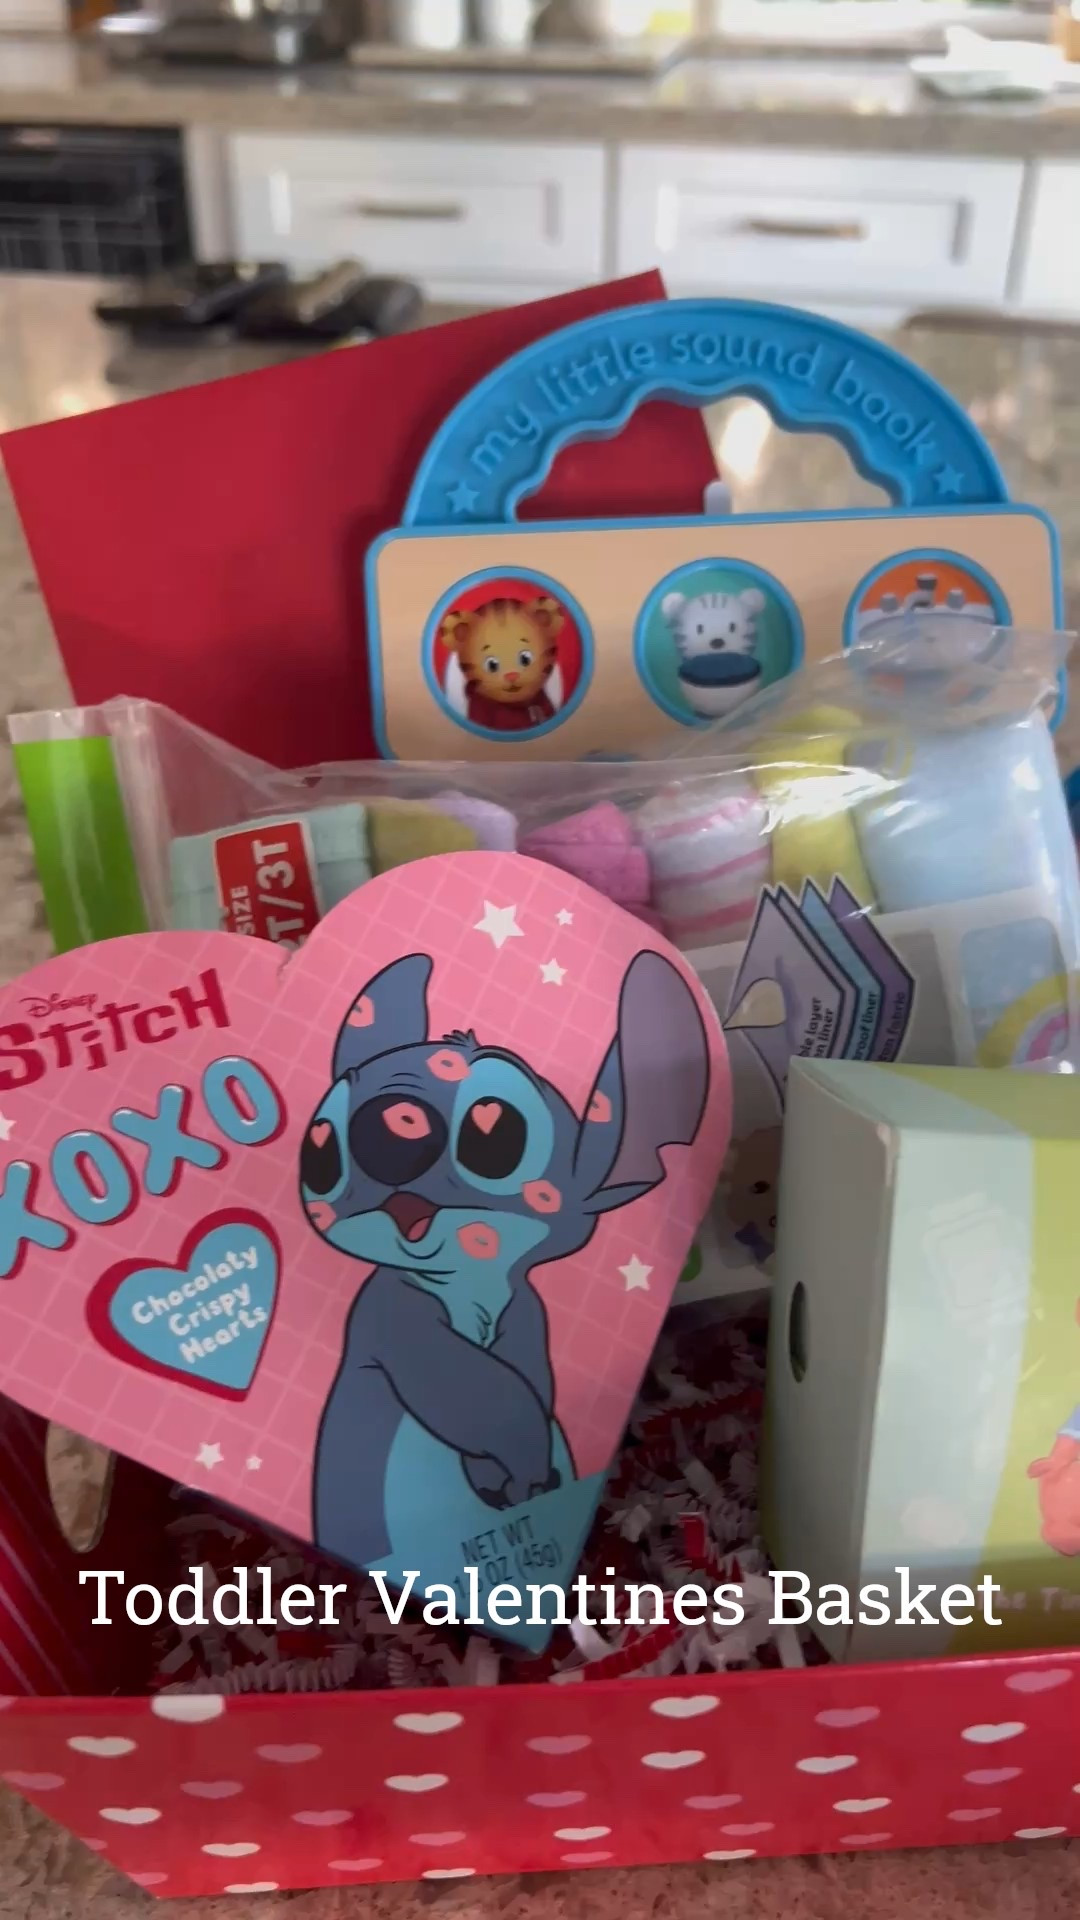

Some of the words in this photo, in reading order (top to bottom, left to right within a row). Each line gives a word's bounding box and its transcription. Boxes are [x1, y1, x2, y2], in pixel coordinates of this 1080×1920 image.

[469, 402, 544, 476] my
[535, 336, 655, 415] little
[670, 331, 823, 387] sound
[832, 359, 937, 465] book
[230, 885, 256, 936] SIZE
[804, 997, 822, 1035] layer
[818, 1007, 834, 1042] liner
[862, 991, 878, 1024] liner
[131, 1246, 259, 1325] Chocolaty
[168, 1282, 251, 1336] Crispy
[179, 1306, 268, 1364] Hearts
[461, 1529, 496, 1565] NET
[502, 1515, 533, 1547] WT
[485, 1556, 514, 1586] OZ
